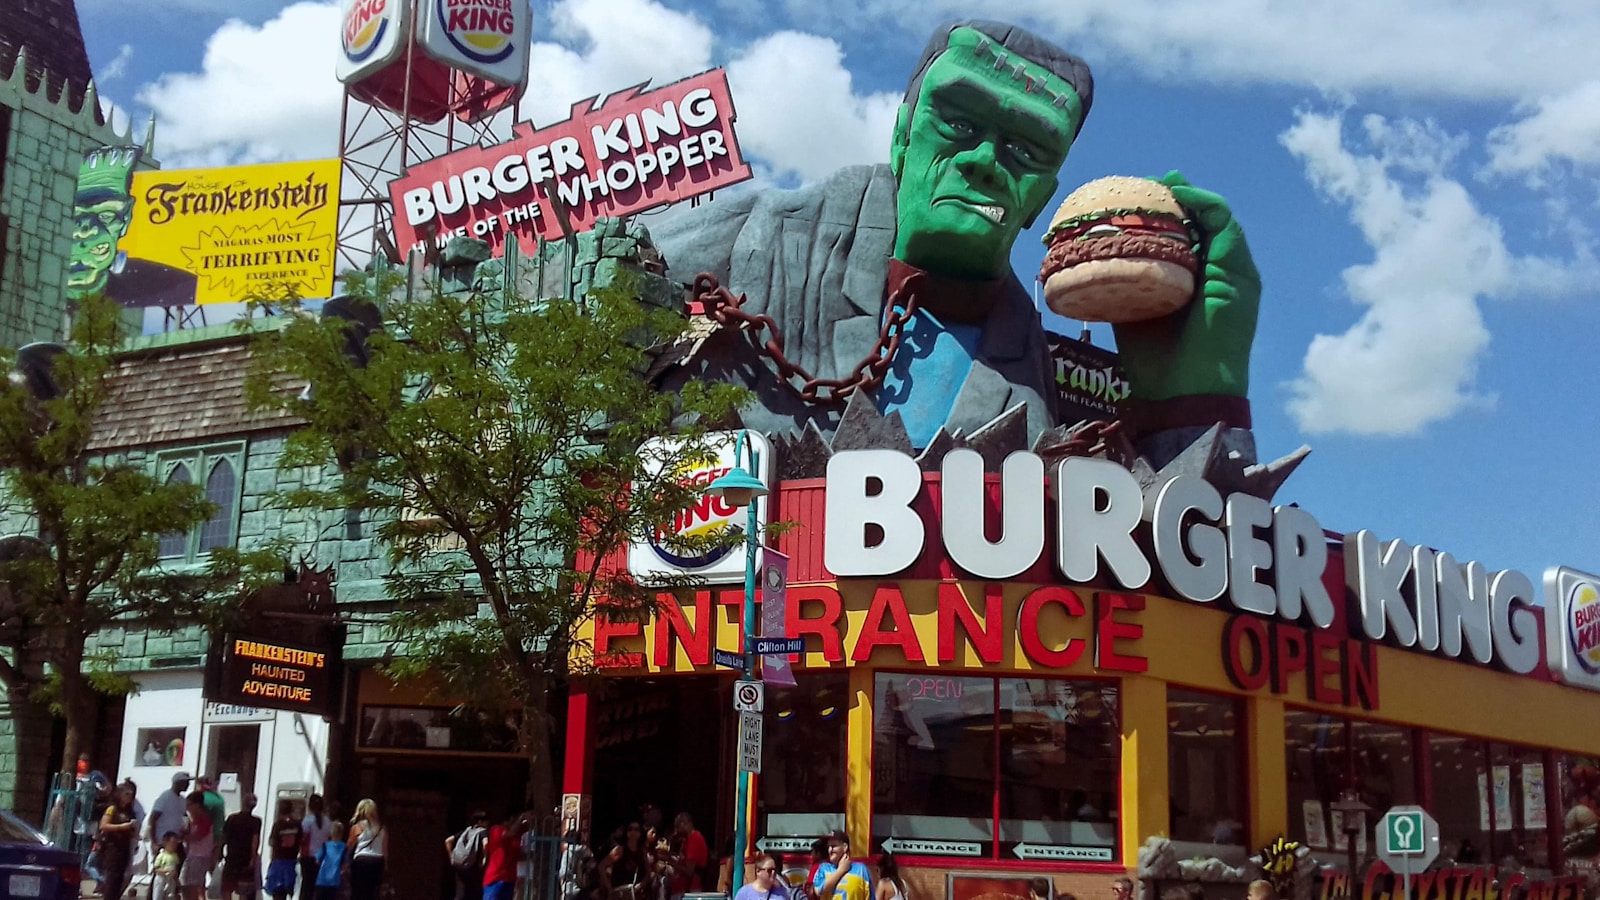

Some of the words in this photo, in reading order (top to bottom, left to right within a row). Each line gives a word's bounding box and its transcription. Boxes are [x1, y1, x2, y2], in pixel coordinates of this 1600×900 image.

[448, 8, 514, 35] KING
[403, 136, 585, 226] BURGER
[591, 88, 718, 160] KING
[145, 171, 329, 225] Frankenstein
[411, 226, 467, 254] HME
[473, 215, 499, 236] OF
[503, 202, 541, 229] THE
[545, 129, 727, 207] WHOPPER
[266, 232, 303, 244] MOST
[201, 248, 321, 269] TERRIFYING
[245, 269, 309, 281] EXPERIENCE
[1060, 390, 1079, 403] THE
[1080, 396, 1104, 409] FEAR
[823, 448, 1335, 629] BURGER
[1346, 528, 1540, 675] KING
[593, 582, 1149, 673] ENTRANCE
[757, 642, 786, 653] Clifton
[787, 640, 802, 651] Hill
[1576, 622, 1600, 654] KI
[234, 639, 325, 668] FRANKENSTEIN'S
[1221, 614, 1380, 711] OPEN
[251, 663, 306, 682] HAUNTED
[241, 680, 312, 701] ADVENTURE
[906, 678, 963, 699] OPEN
[744, 716, 761, 730] RIGHT
[744, 730, 759, 743] LANE
[744, 742, 759, 756] MUST
[744, 755, 759, 768] TURN
[765, 841, 813, 850] ENTRA
[891, 843, 978, 853] ENTRANCE
[1023, 848, 1109, 858] ENTRANCE
